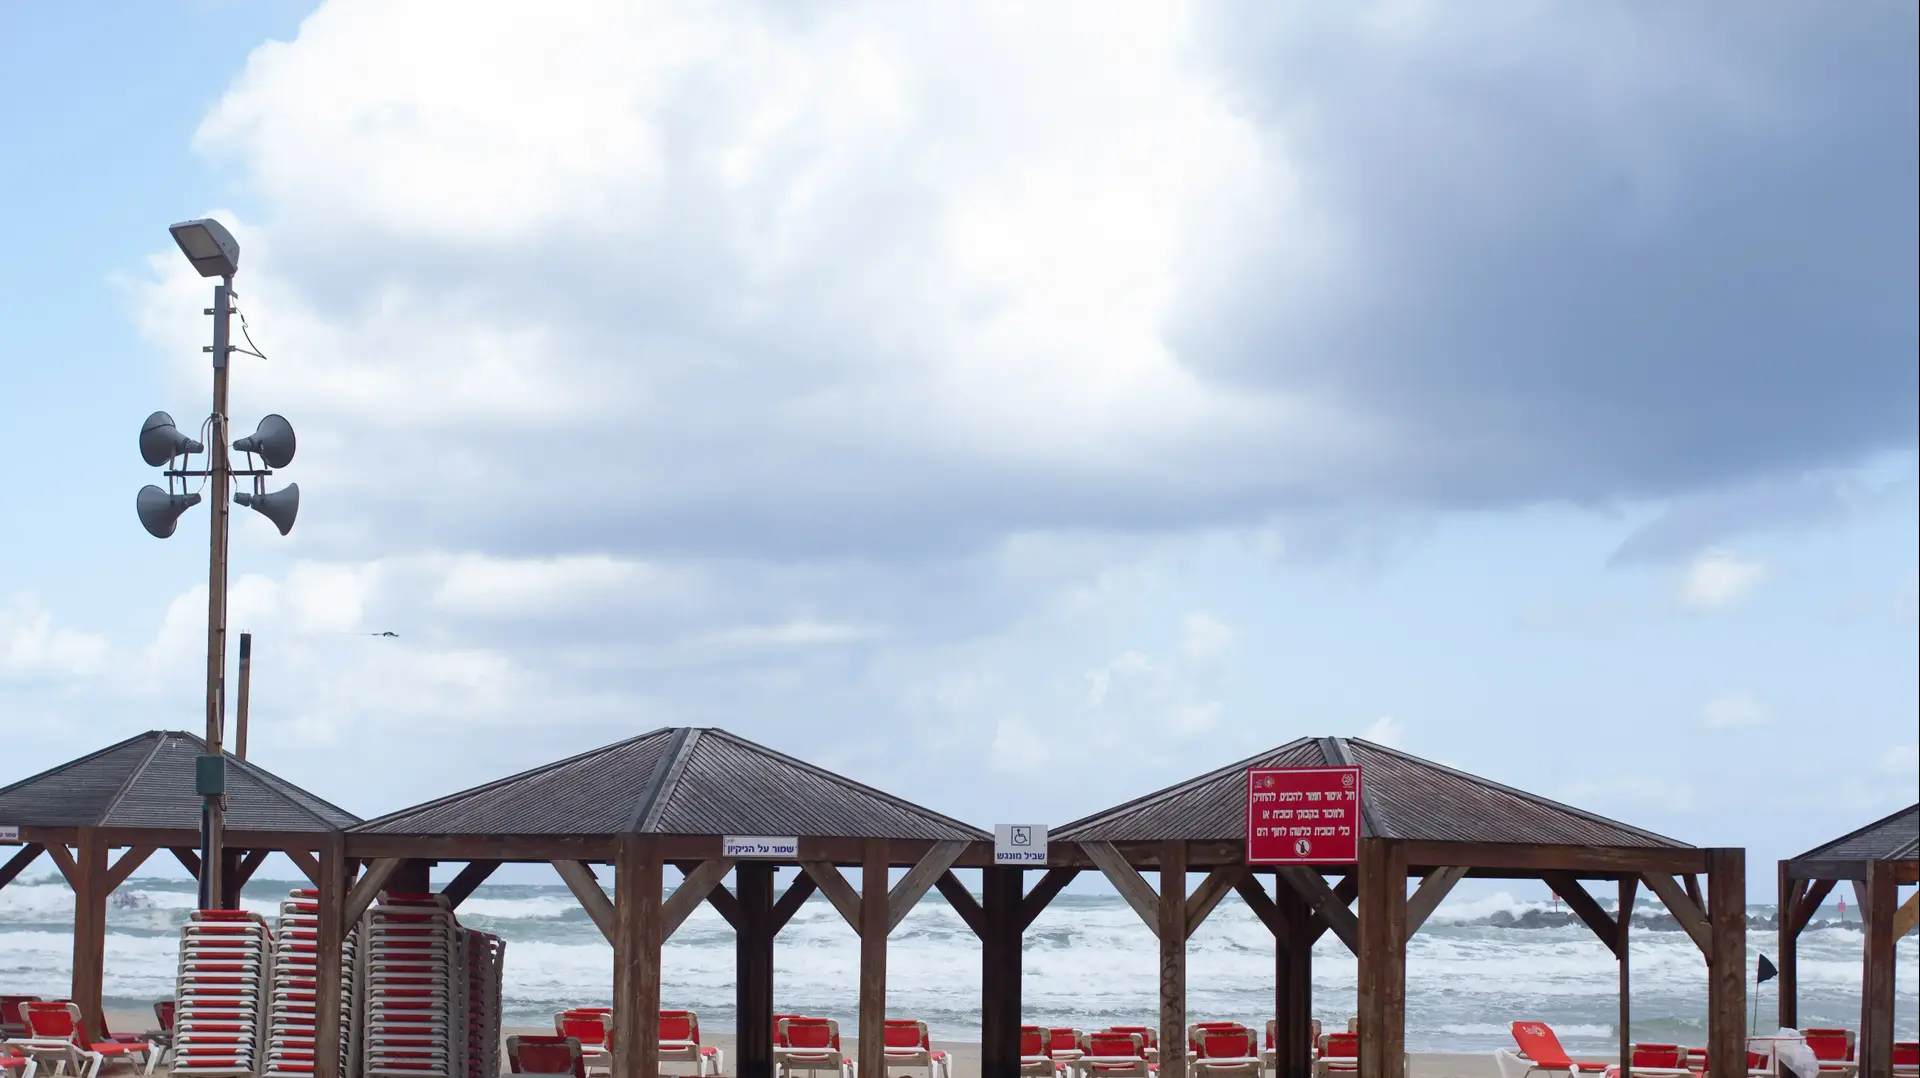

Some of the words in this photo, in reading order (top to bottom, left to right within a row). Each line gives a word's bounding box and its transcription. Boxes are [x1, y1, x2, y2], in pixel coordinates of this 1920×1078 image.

[1253, 792, 1276, 803] להחזיק
[1306, 791, 1321, 801] חמור
[1324, 791, 1342, 800] איסור
[1345, 790, 1355, 800] חל
[1262, 809, 1270, 819] או
[1272, 809, 1293, 819] זכוכית
[1322, 808, 1344, 818] ולמכור
[1256, 827, 1268, 836] הים
[1271, 825, 1287, 837] לחוף
[1314, 826, 1335, 836] זכוכית
[1338, 825, 1350, 836] כלי
[727, 845, 755, 855] הניקיון
[757, 844, 769, 853] על
[772, 845, 794, 853] שמור
[996, 852, 1022, 860] מונגש
[1023, 851, 1046, 860] שביל
